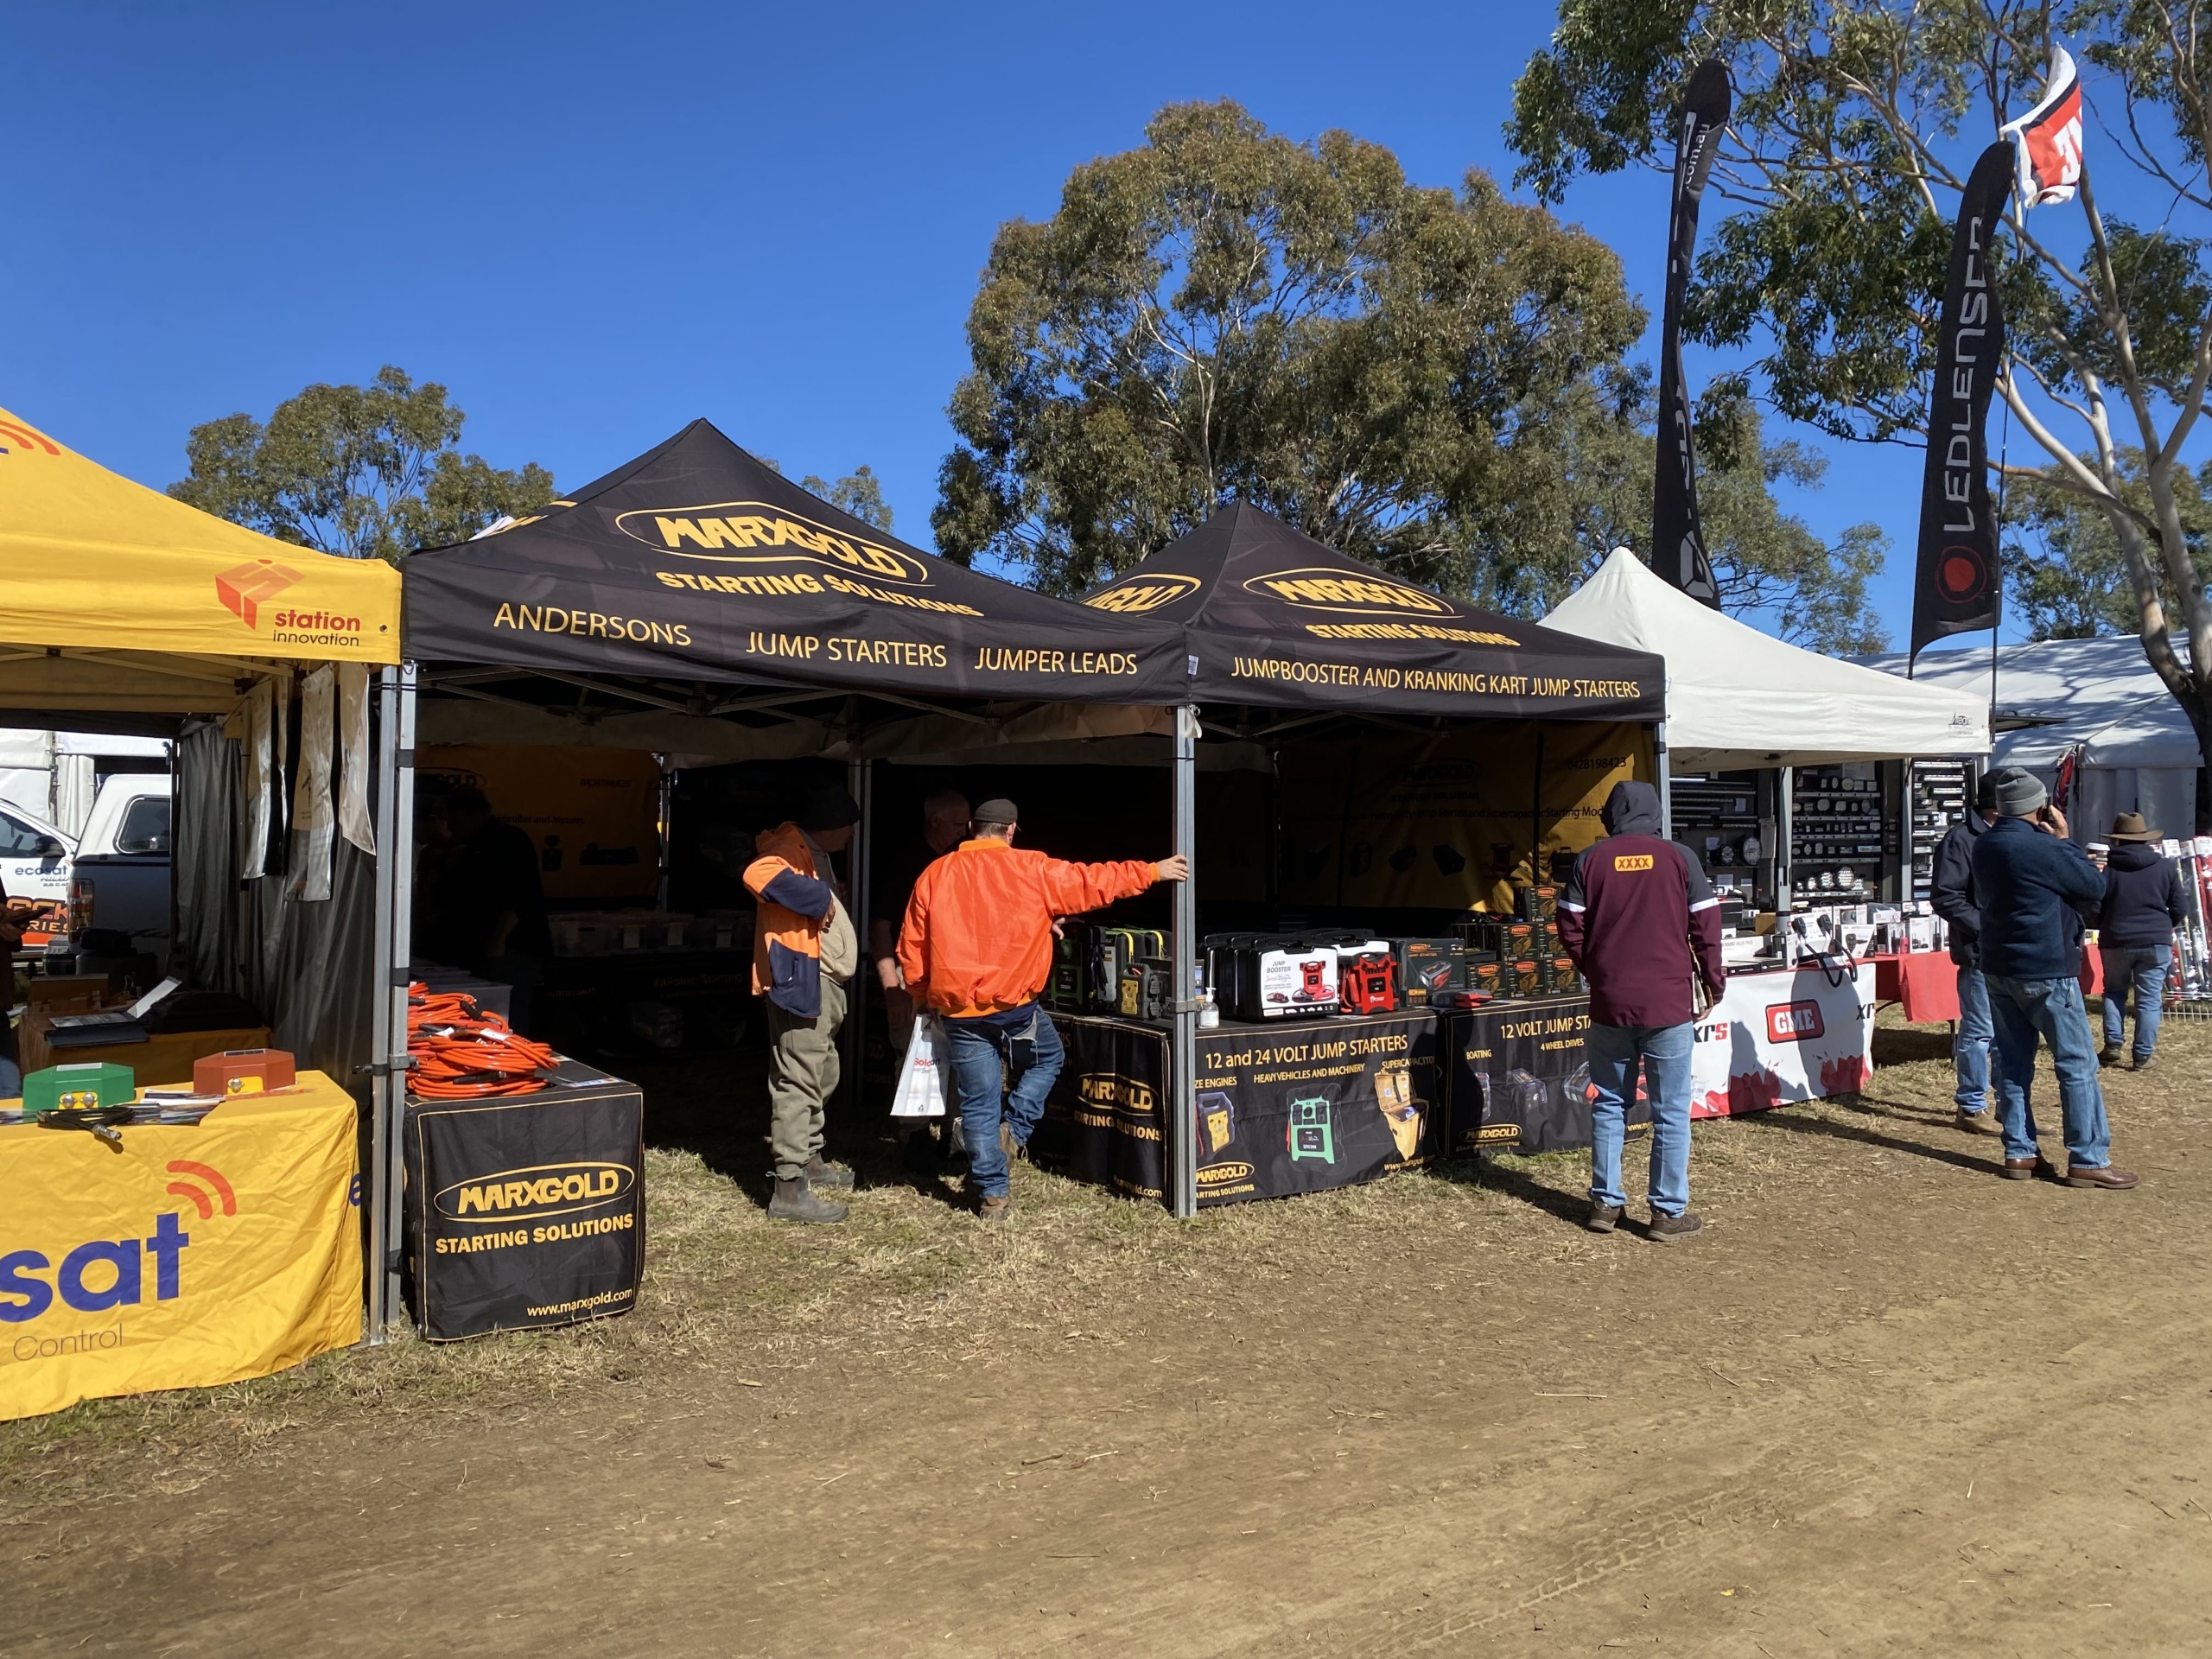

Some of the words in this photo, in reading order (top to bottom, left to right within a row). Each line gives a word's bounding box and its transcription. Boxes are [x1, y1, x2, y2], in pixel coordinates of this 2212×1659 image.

[654, 516, 907, 578] MARXGOLD
[656, 571, 825, 594] STARTING
[823, 574, 985, 617] SOLUTIONS
[1263, 579, 1443, 612] MARXGOLD
[274, 608, 360, 632] station
[272, 630, 359, 647] innovation
[493, 602, 692, 646] ANDERSONS
[746, 631, 820, 658] JUMP
[828, 637, 947, 667] STARTERS
[974, 647, 1065, 672] JUMPER
[1070, 652, 1138, 675] LEADS
[1306, 623, 1421, 639] STARTING
[1412, 624, 1521, 646] SOLUTIONS
[1231, 657, 1359, 685] JUMPBOOSTER
[1363, 666, 1400, 688] AND
[1404, 670, 1485, 693] KRANKING
[1490, 675, 1529, 695] KART
[1531, 677, 1571, 696] JUMP
[1573, 679, 1641, 698] STARTERS
[1546, 807, 1580, 819] Starting
[15, 866, 67, 875] ecosat
[1618, 858, 1650, 869] XXXX
[1500, 1024, 1515, 1039] 12
[1516, 1020, 1543, 1037] VOLT
[1545, 1017, 1574, 1034] JUMP
[1774, 1008, 1815, 1035] GME
[1205, 1052, 1222, 1069] 12
[1226, 1049, 1252, 1067] and
[1255, 1049, 1271, 1065] 24
[1274, 1045, 1309, 1064] VOLT
[1311, 1041, 1347, 1061] JUMP
[1350, 1034, 1408, 1056] STARTERS
[1465, 1049, 1492, 1060] BOATING
[1540, 1042, 1546, 1051] 4
[1545, 1040, 1565, 1051] WHEEL
[1565, 1038, 1584, 1048] DRIVES
[1205, 1076, 1237, 1088] ENGINES
[1254, 1072, 1277, 1084] HEAVY
[1276, 1070, 1311, 1080] VEHICLES
[1312, 1068, 1327, 1077] AND
[1328, 1063, 1365, 1076] MACHINERY
[1195, 1165, 1248, 1184] MARXGOLD
[457, 1170, 619, 1215] MARXGOLD
[1220, 1184, 1255, 1195] SOLUTIONS
[435, 1230, 529, 1254] STARTING
[532, 1213, 633, 1243] SOLUTIONS
[526, 1288, 633, 1317] www.marxgold.com
[12, 1323, 124, 1361] Control
